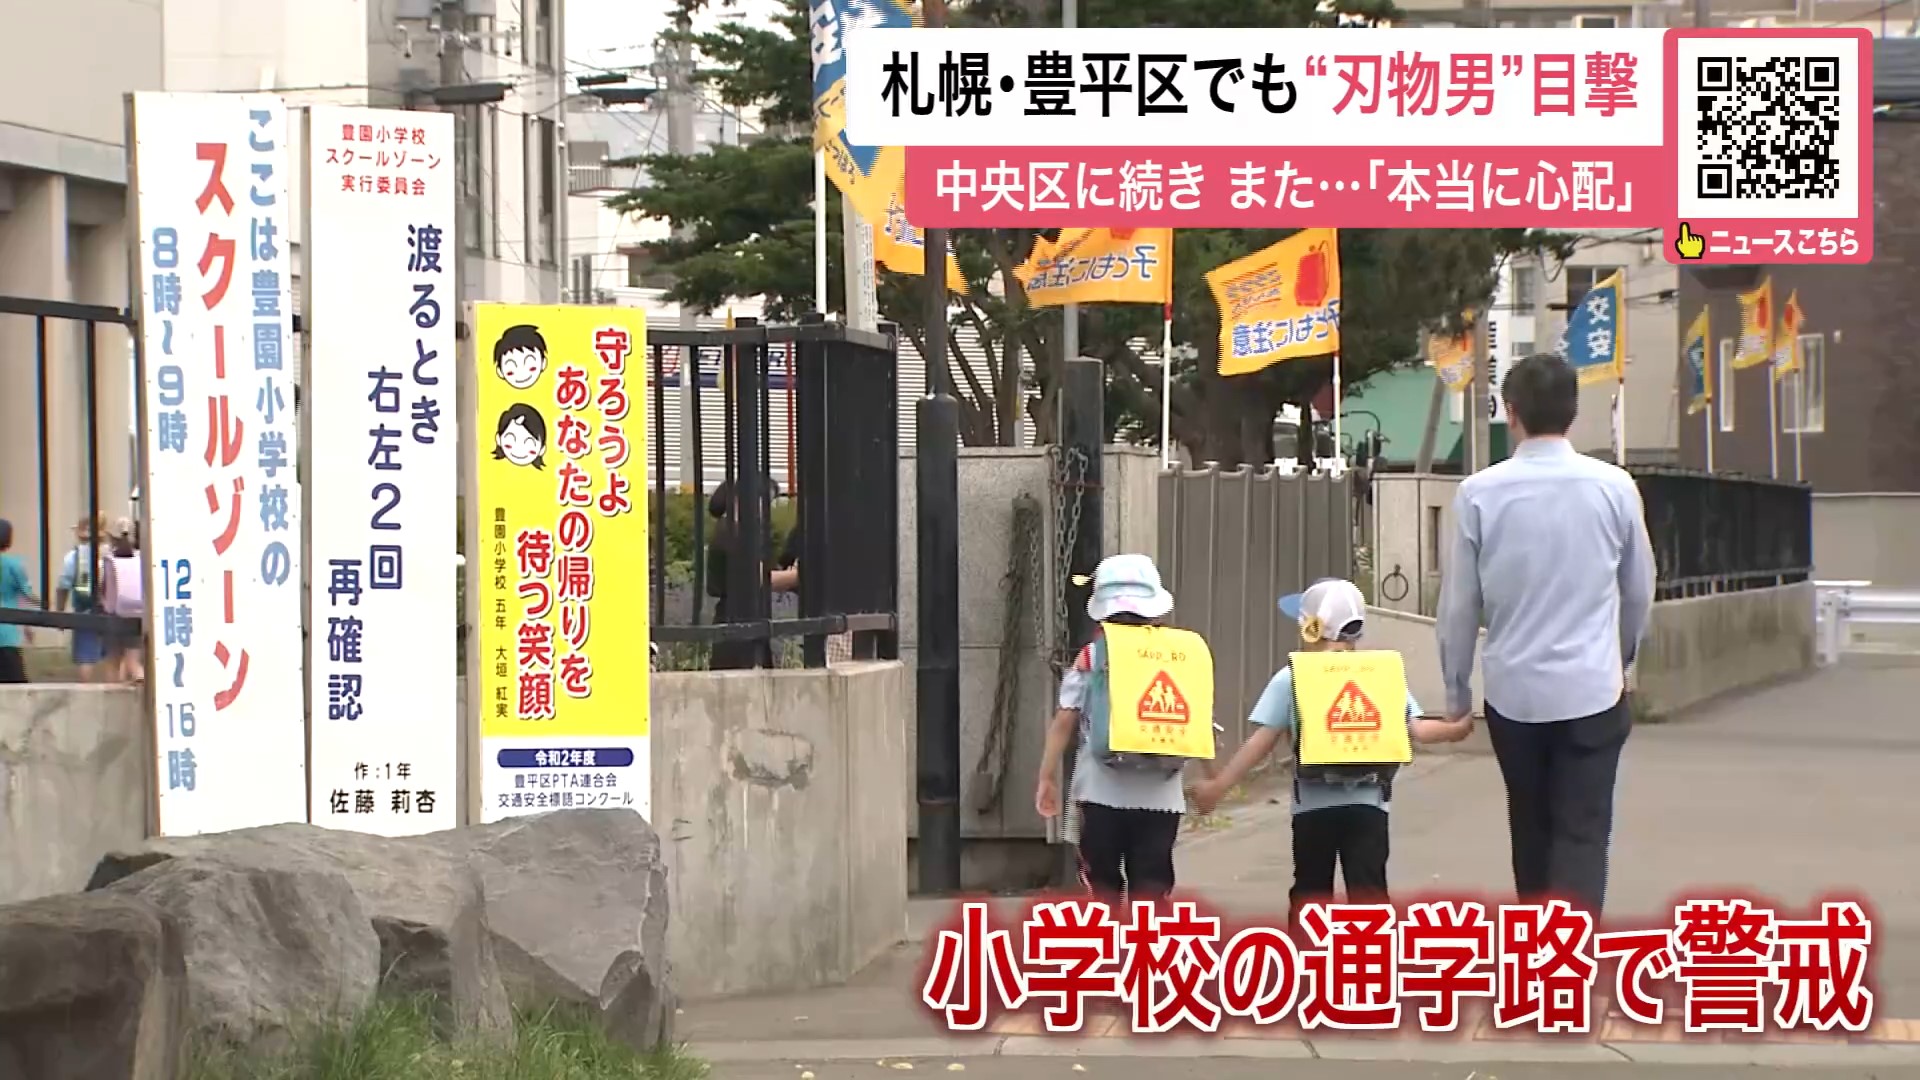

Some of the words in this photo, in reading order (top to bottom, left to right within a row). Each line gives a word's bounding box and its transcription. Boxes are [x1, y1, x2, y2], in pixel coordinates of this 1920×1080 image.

[341, 123, 426, 146] 豊園小学校
[326, 147, 441, 169] スクールゾーン
[341, 174, 426, 196] 実行委員会
[248, 109, 291, 587] ここは豊園小学校の
[407, 224, 443, 444] 渡るとき
[195, 142, 250, 712] スクールゾーン
[594, 327, 630, 513] 守ろうよ
[367, 365, 403, 590] 右左2回
[555, 366, 593, 694] あなたの帰りを
[494, 507, 507, 590] 豊園小学校
[495, 598, 507, 631] 五年
[516, 530, 552, 716] 待つ笑顔
[327, 558, 364, 721] 再確認
[495, 644, 508, 678] 大垣
[354, 761, 412, 781] 作:1年
[534, 750, 597, 766] 令和2年度
[514, 772, 618, 789] 豊平区PTA連合会
[330, 788, 375, 814] 佐藤
[391, 788, 437, 814] 莉杏
[497, 791, 635, 808] 交通安全標語コンクール
